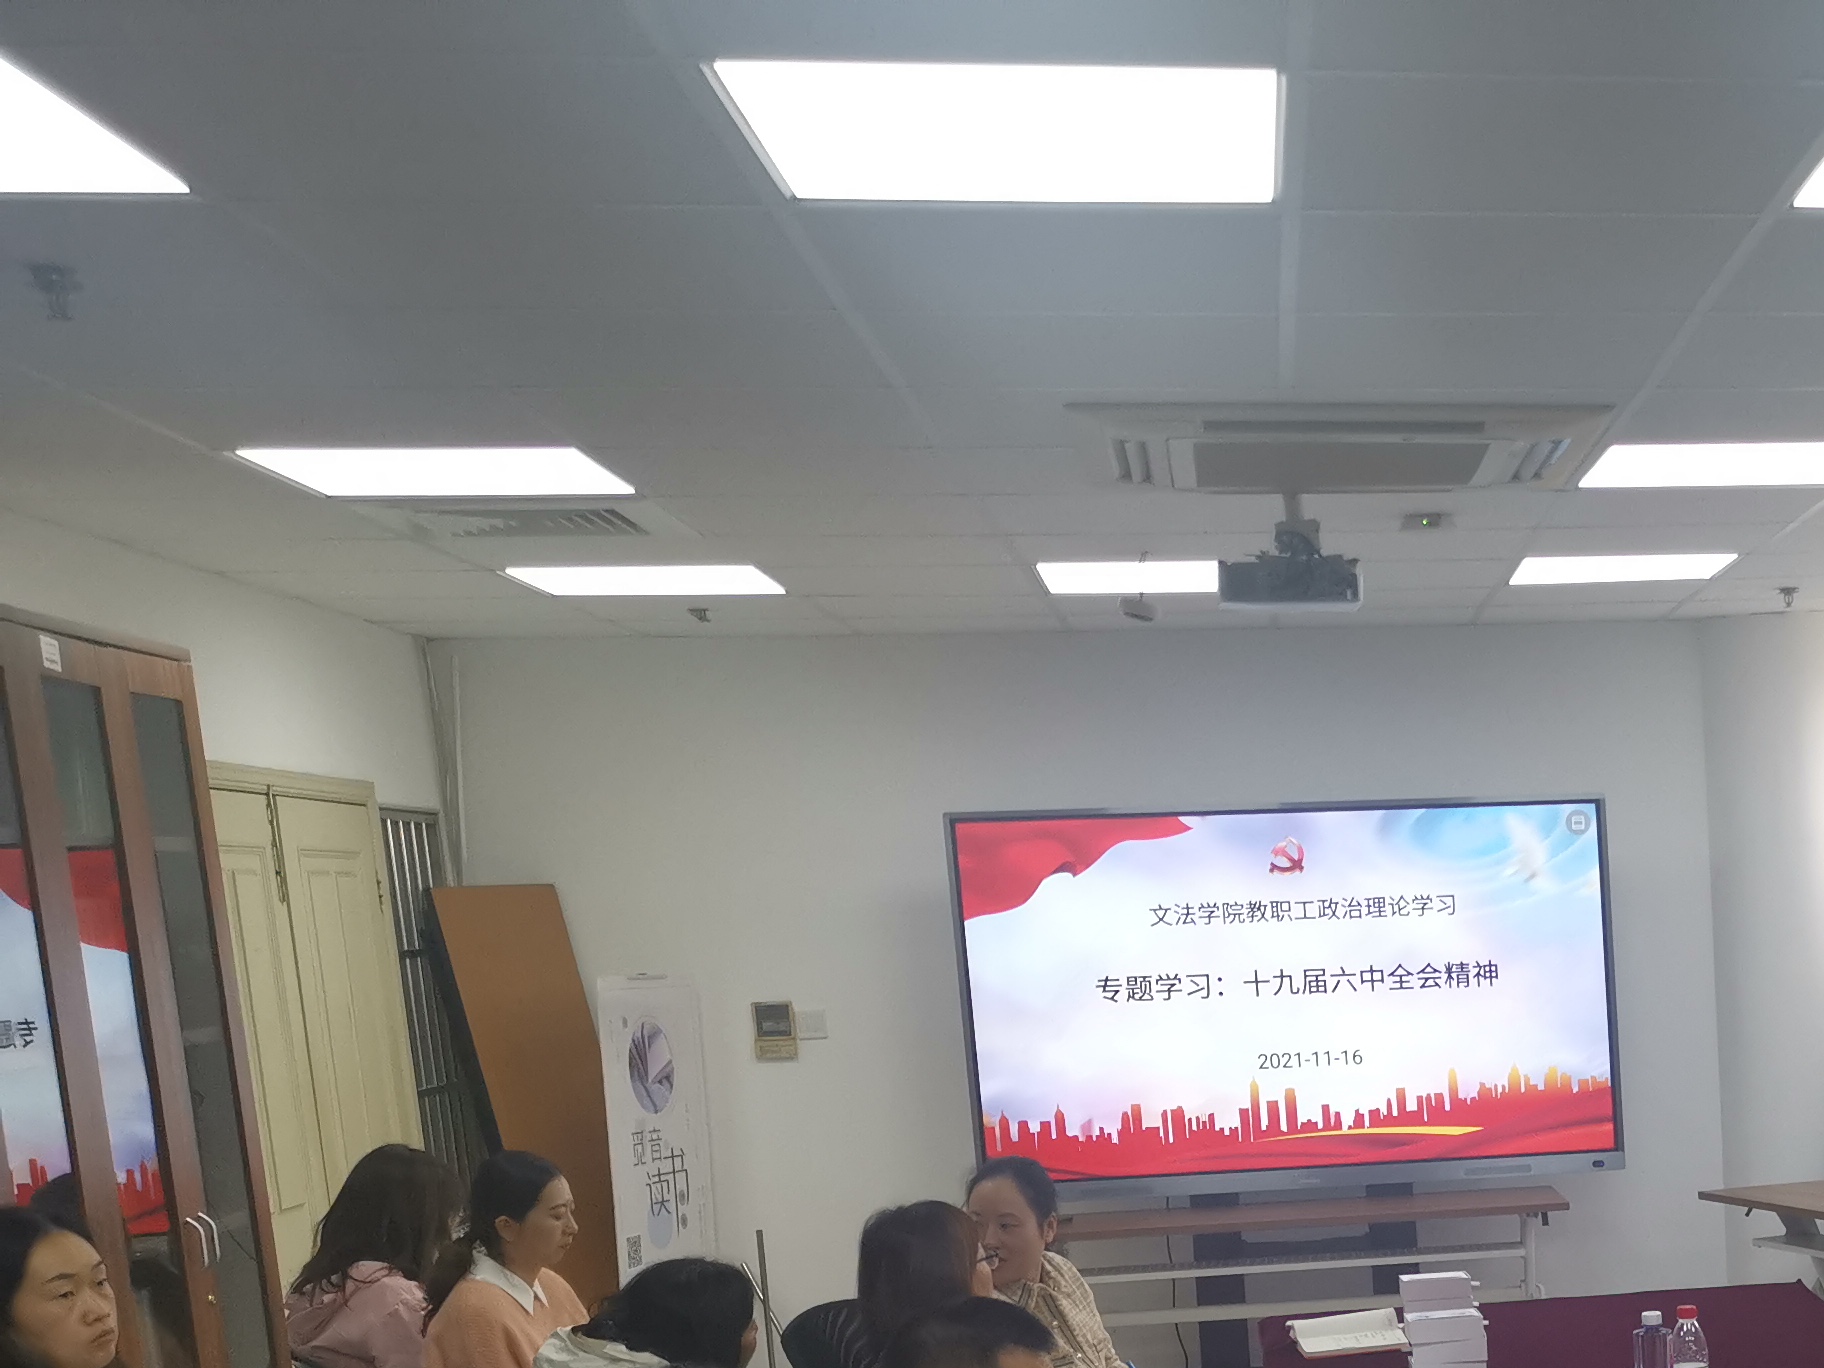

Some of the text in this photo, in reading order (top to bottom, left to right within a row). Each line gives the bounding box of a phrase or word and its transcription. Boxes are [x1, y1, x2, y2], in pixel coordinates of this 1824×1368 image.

[1148, 894, 1457, 928] 文法学院教职工政治理论学习
[1257, 1049, 1363, 1070] 2021-11-16
